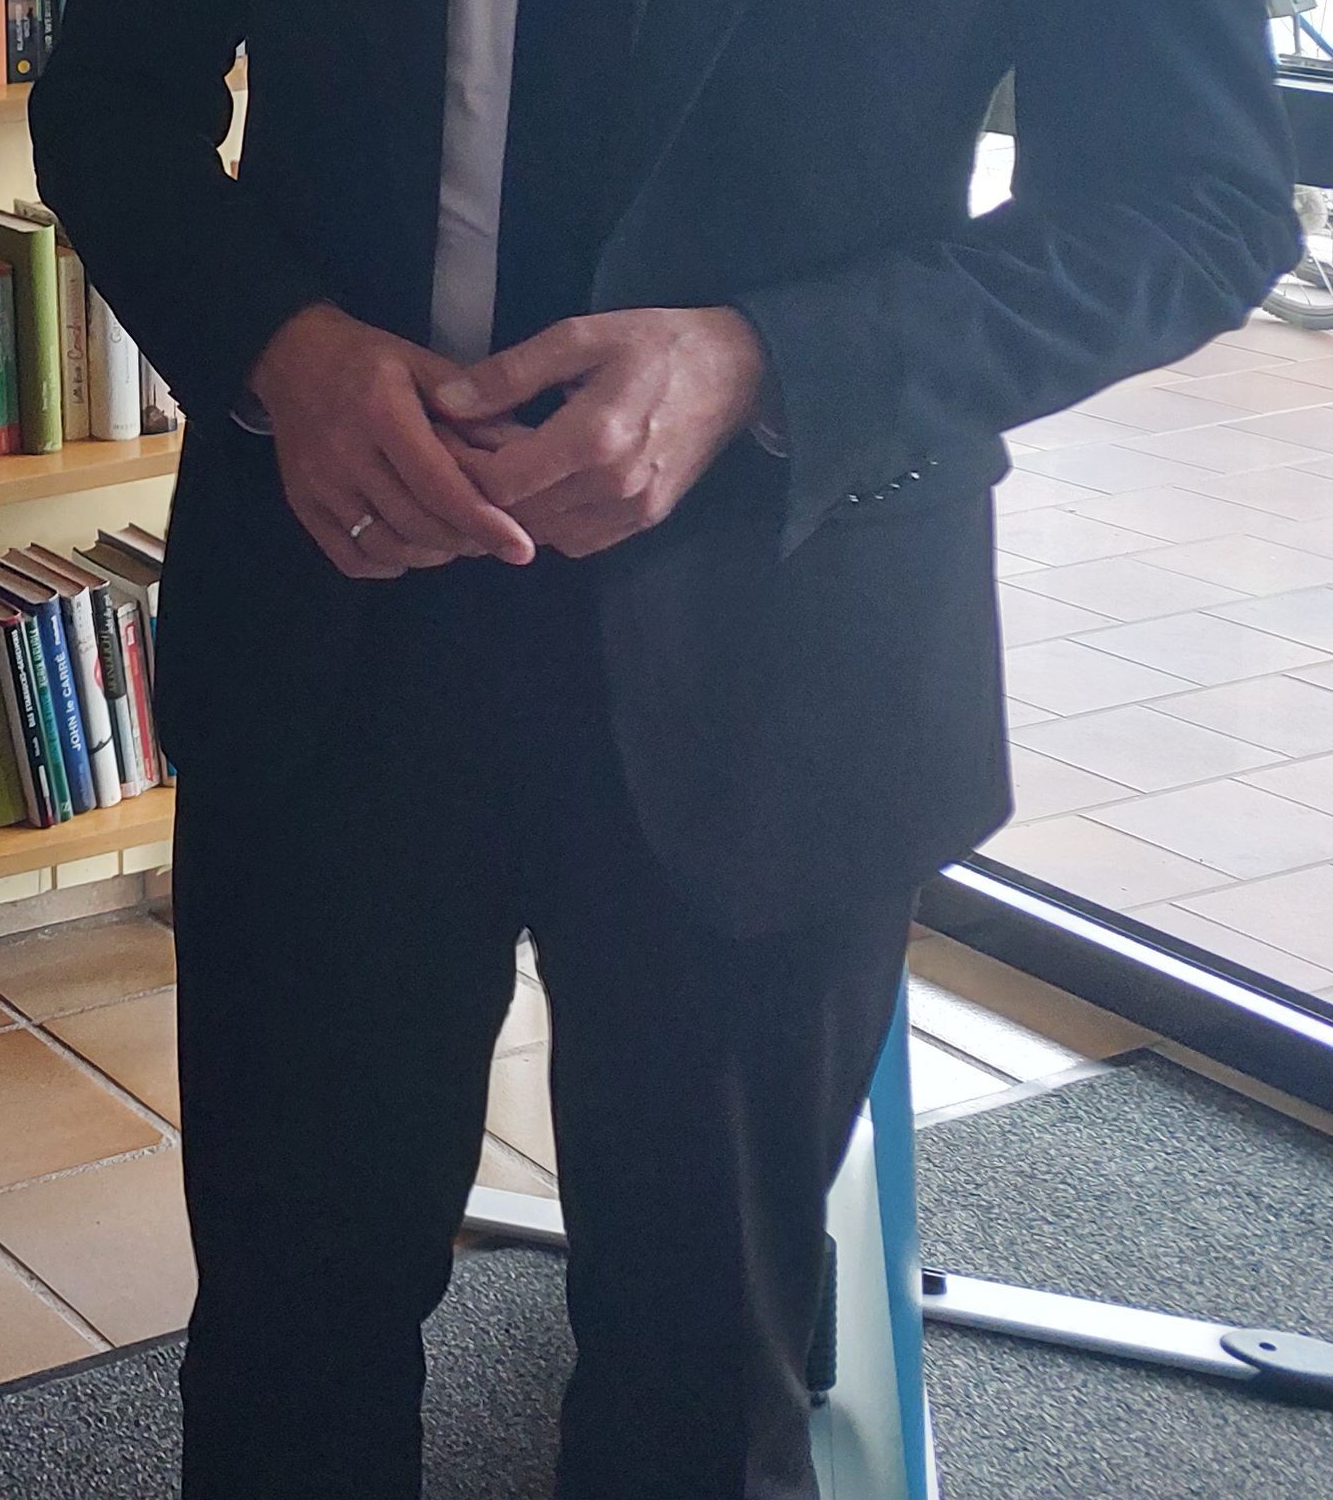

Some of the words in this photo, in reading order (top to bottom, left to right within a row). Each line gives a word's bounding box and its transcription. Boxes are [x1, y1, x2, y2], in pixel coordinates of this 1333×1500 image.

[54, 651, 72, 698] CARRÉ
[66, 700, 76, 713] le
[69, 715, 82, 751] JOHN
